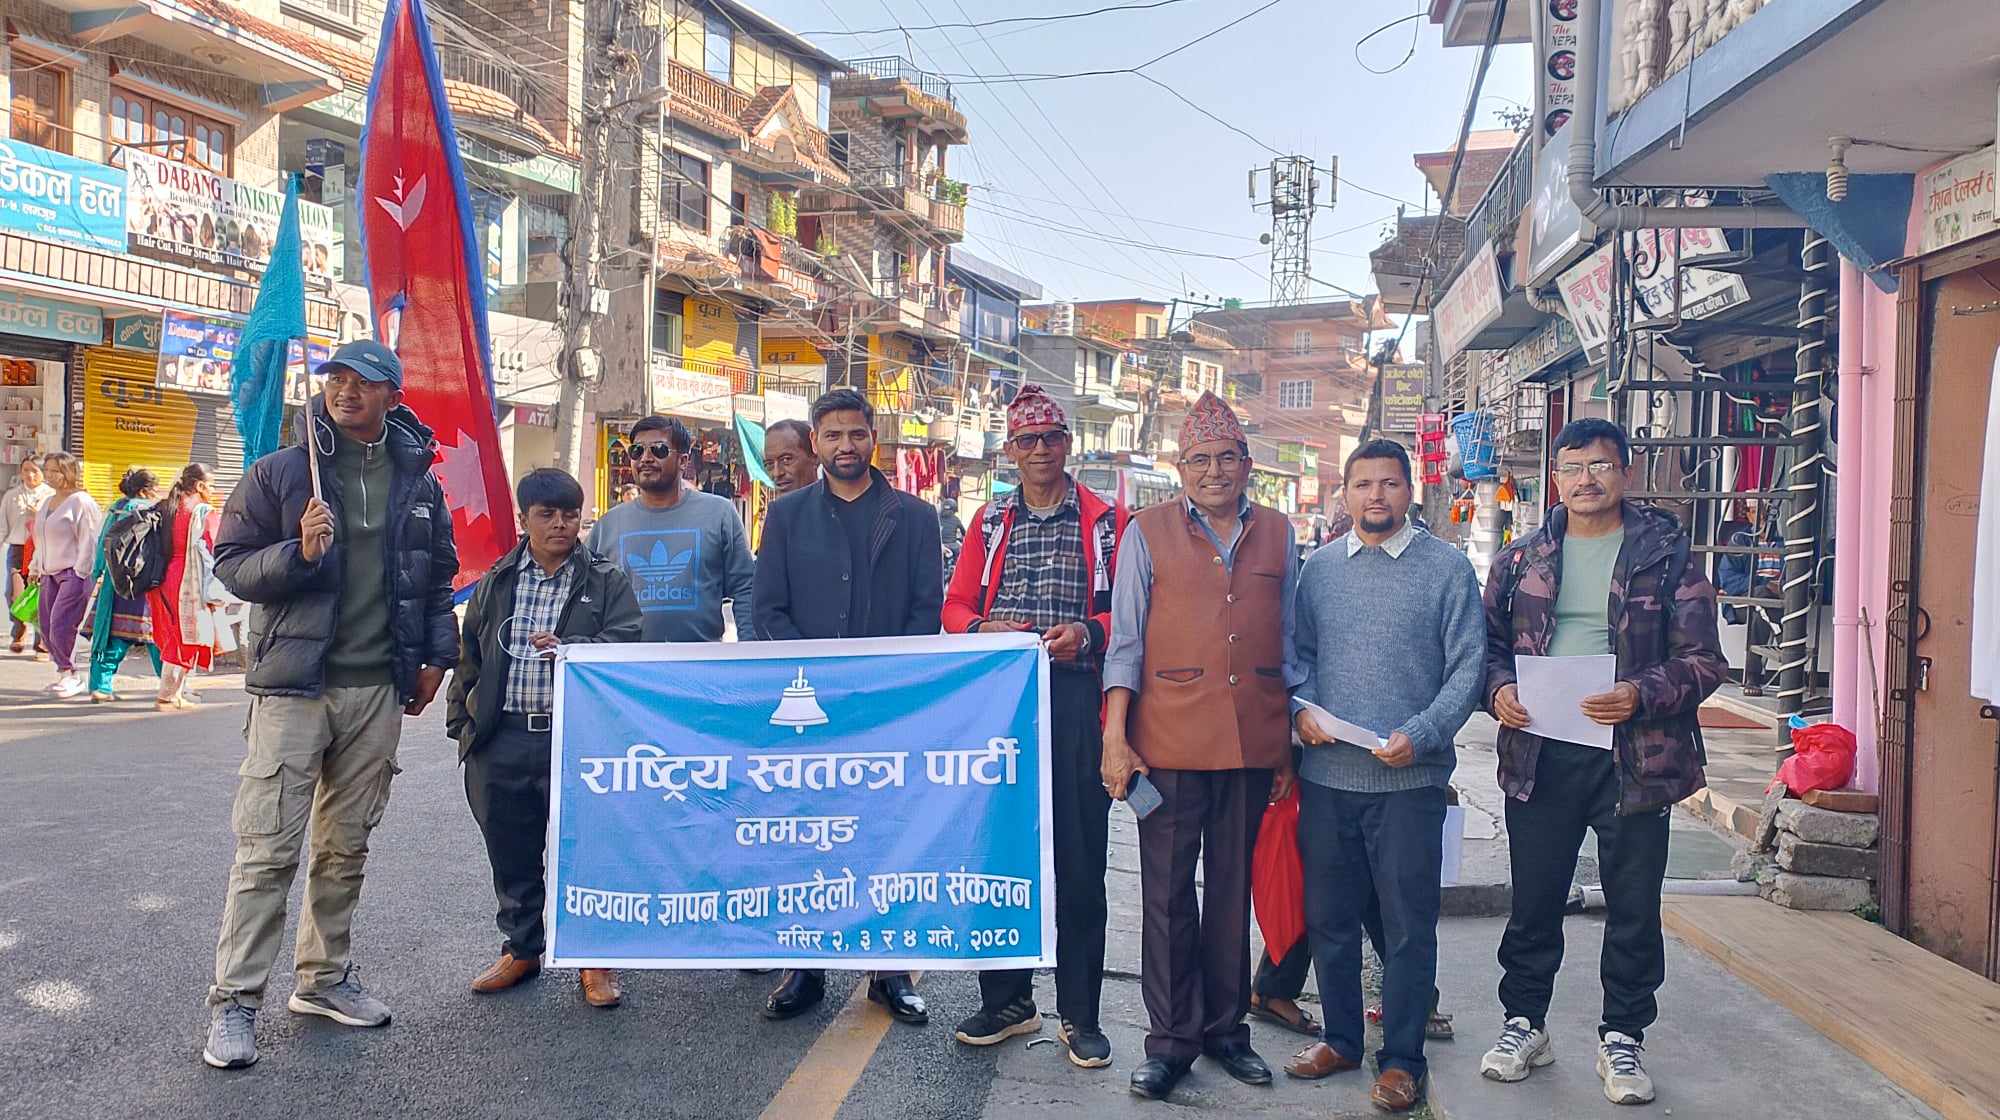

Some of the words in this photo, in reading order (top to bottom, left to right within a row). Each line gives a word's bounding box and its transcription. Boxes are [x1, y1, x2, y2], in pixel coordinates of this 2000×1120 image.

[1552, 36, 1577, 46] NEPA
[1548, 95, 1574, 105] NEPA
[0, 142, 72, 206] डिकल
[80, 176, 122, 218] हल
[530, 160, 570, 184] SAHAR
[158, 161, 222, 201] DABANG
[233, 182, 280, 216] UNISEX
[299, 202, 329, 228] ALON
[137, 234, 156, 247] Hair
[175, 243, 193, 256] Hair
[244, 257, 268, 272] Colou
[0, 301, 48, 328] कल
[57, 309, 100, 336] हल
[580, 743, 733, 801] राष्ट्रिय
[747, 751, 909, 793] स्वतन्त्र
[924, 737, 1020, 785] पार्टी
[736, 815, 860, 851] लमजुङ
[565, 884, 651, 926] धन्यवाद
[658, 890, 720, 926] ज्ञापन
[726, 886, 771, 922] तथा
[777, 867, 860, 914] घरदैलो,
[868, 872, 939, 915] सुझाव
[946, 865, 1032, 909] संकलन
[832, 930, 849, 952] २,
[860, 930, 871, 950] ३
[881, 929, 896, 951] र
[903, 930, 917, 948] ४
[927, 925, 959, 951] गते,
[970, 928, 1020, 950] २०८०
